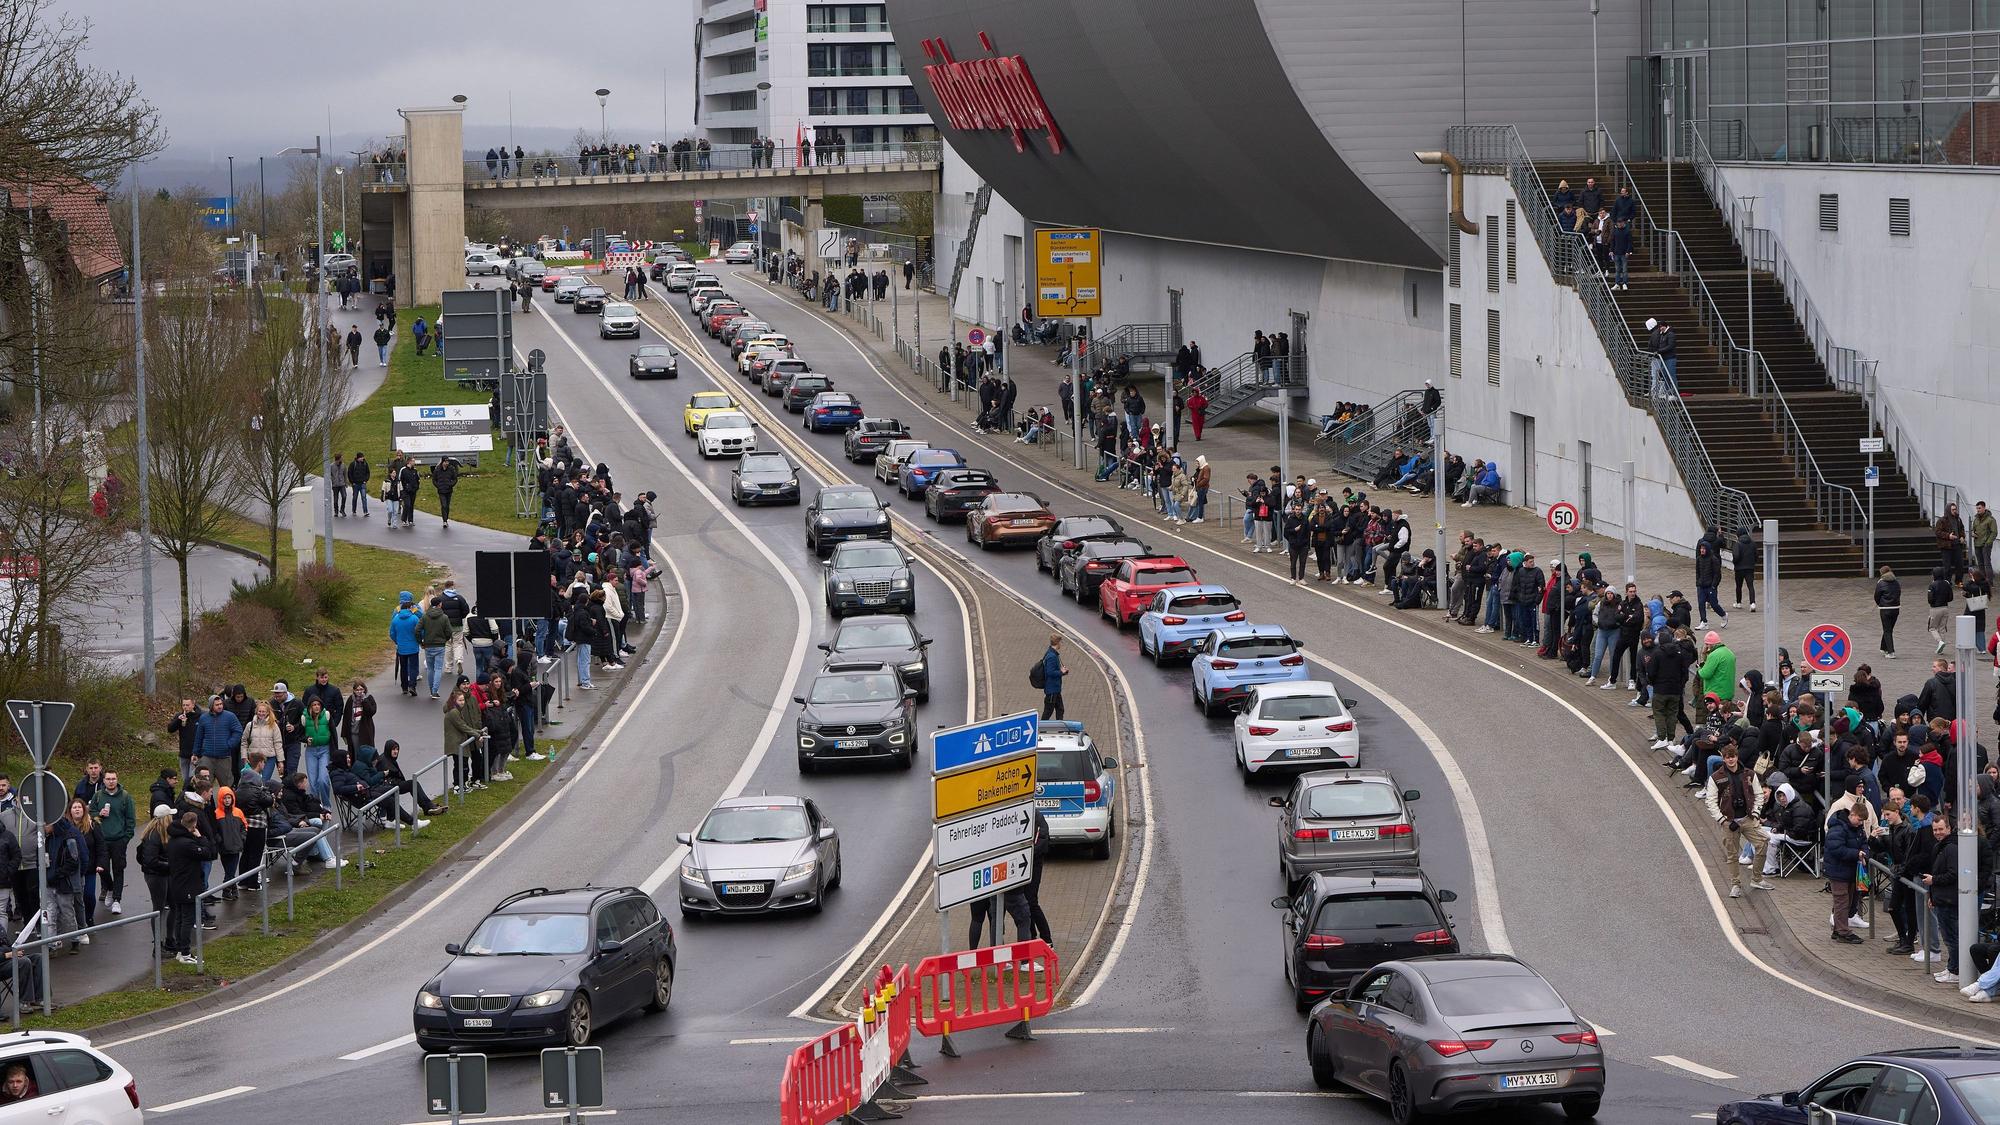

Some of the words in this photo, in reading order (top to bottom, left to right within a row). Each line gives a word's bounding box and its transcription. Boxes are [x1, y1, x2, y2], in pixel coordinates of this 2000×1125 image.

[1555, 511, 1572, 525] 50
[996, 767, 1020, 782] Aachen
[978, 781, 1020, 802] Blankenheim
[991, 811, 1019, 829] Paddock
[949, 821, 988, 842] Fahrerlager
[1337, 830, 1350, 838] VIE
[1365, 829, 1374, 837] 93
[974, 873, 980, 887] B
[984, 869, 990, 884] C
[742, 884, 751, 893] MP
[752, 884, 764, 892] 238
[1507, 1076, 1518, 1086] MY
[1526, 1075, 1538, 1085] XX
[1539, 1074, 1556, 1084] 130
